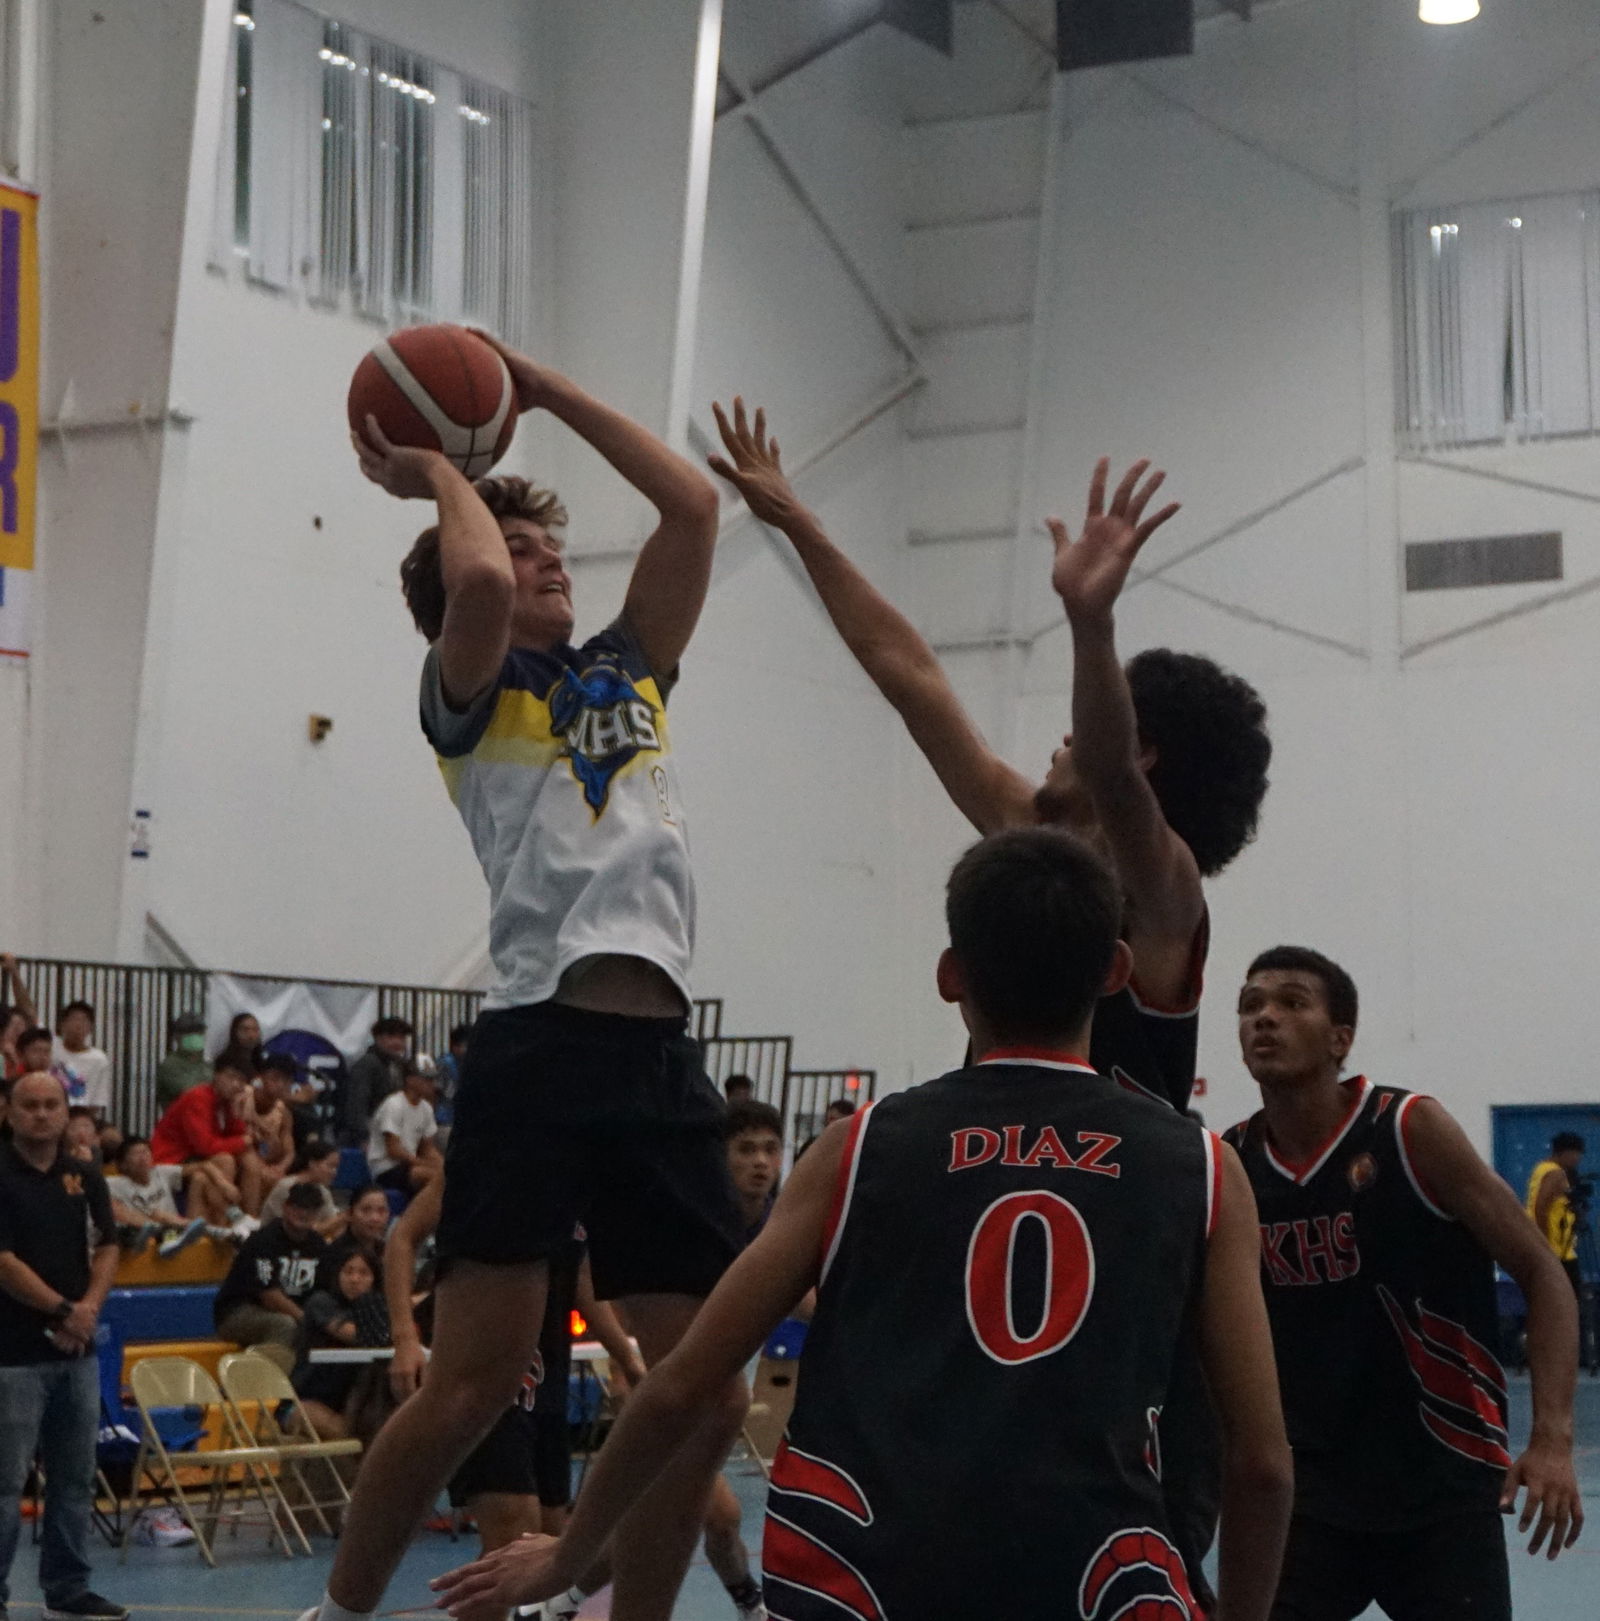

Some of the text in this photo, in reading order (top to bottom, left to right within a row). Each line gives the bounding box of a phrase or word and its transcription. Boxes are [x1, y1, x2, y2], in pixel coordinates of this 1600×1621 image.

[948, 1125, 1121, 1179] DIAZ
[965, 1189, 1096, 1366] 0
[1259, 1211, 1361, 1286] KHS
